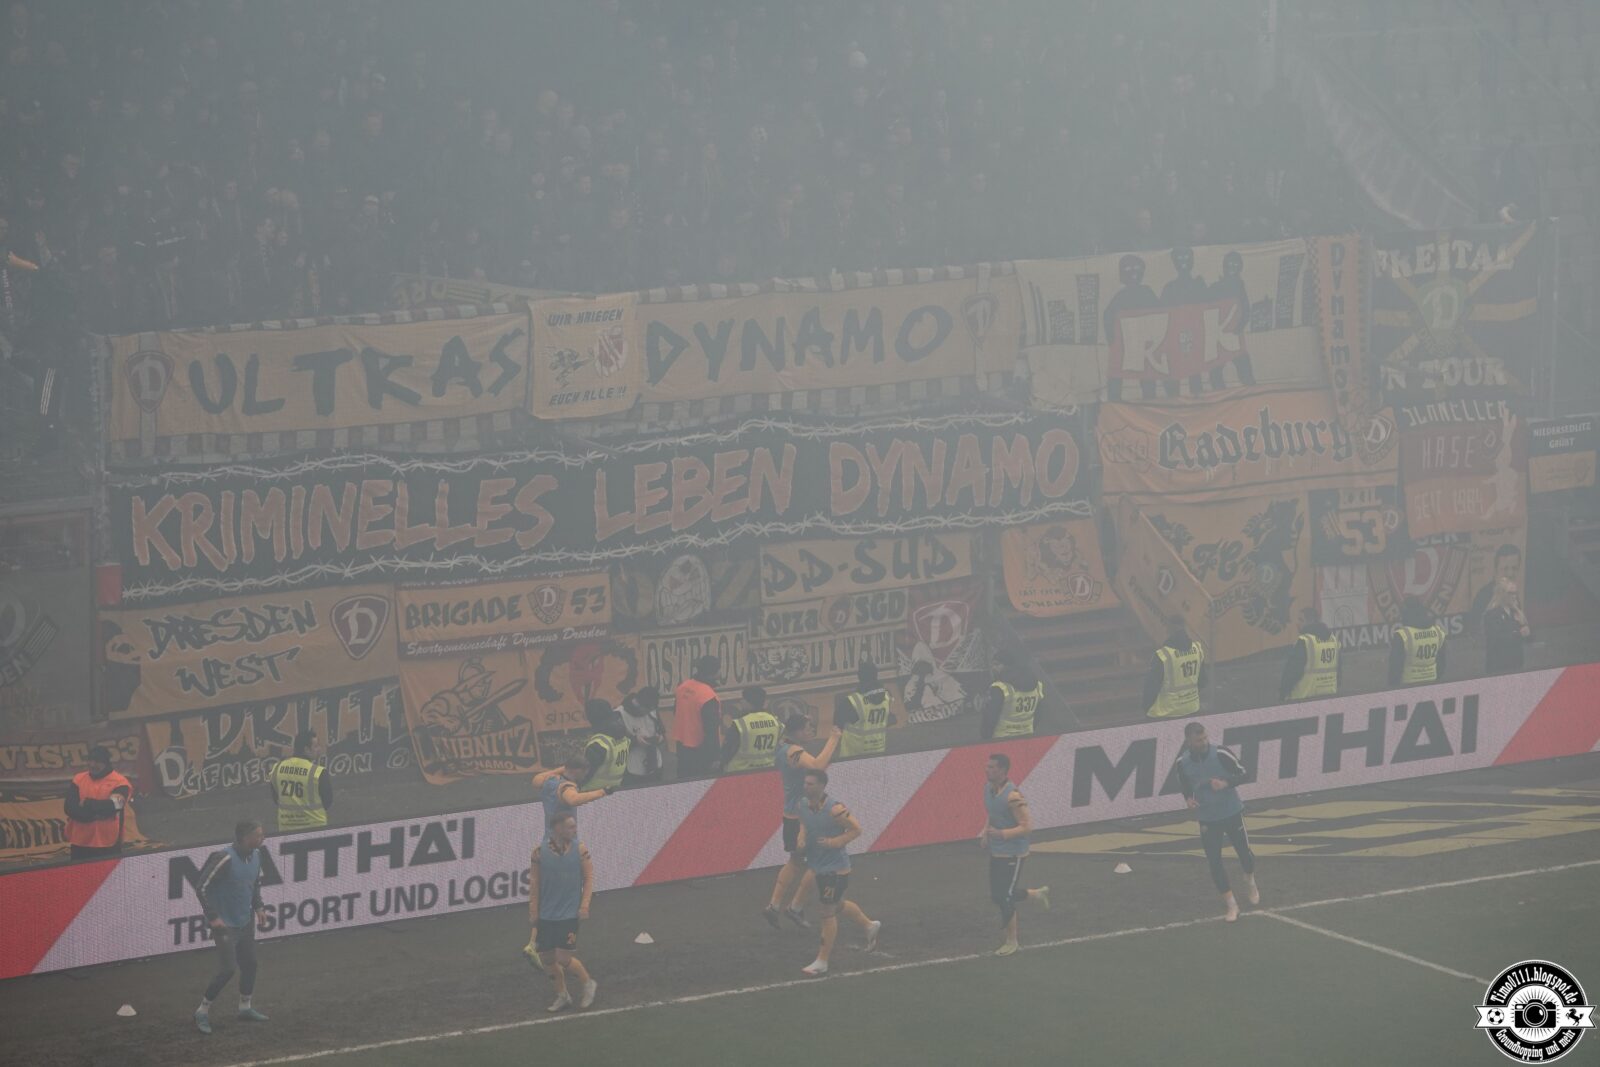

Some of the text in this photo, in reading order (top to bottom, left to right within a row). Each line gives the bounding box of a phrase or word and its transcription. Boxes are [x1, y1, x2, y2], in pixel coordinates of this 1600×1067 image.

[645, 304, 954, 386] DYNAMO
[187, 328, 525, 417] ULTRAS
[130, 428, 1080, 572] KRIMINELLES LEBEN DYNAMO
[1339, 509, 1387, 556] 53
[142, 599, 321, 659] DRESDEN
[405, 594, 523, 631] BRIGADE
[570, 584, 608, 615] 53
[174, 646, 301, 698] WEST
[1415, 644, 1438, 661] 402
[1015, 696, 1037, 713] 337
[753, 733, 775, 751] 472
[279, 780, 304, 798] 276
[369, 882, 439, 916] UND
